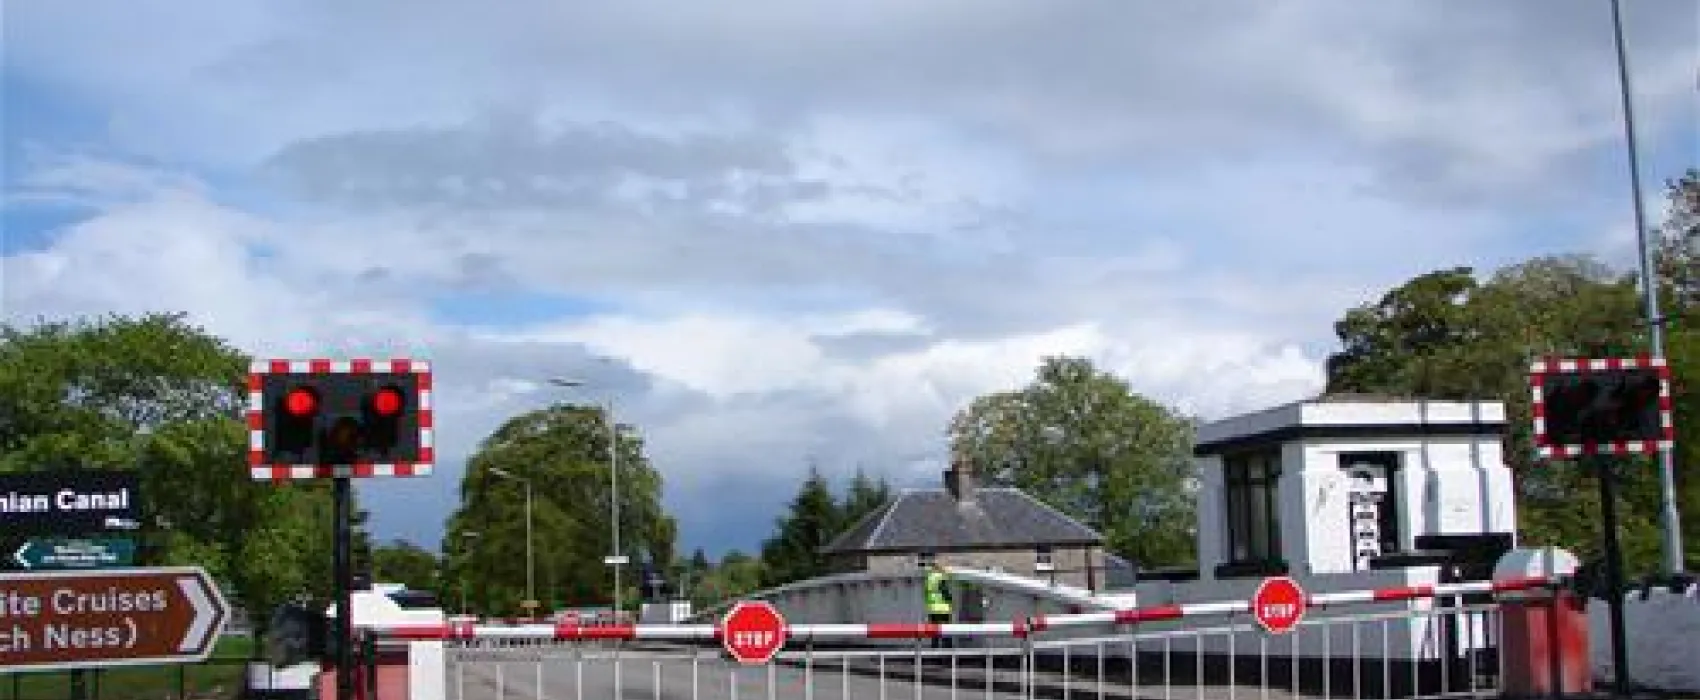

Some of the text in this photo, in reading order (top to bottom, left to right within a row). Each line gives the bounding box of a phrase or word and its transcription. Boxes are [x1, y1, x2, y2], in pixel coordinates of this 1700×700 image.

[56, 488, 129, 511] Canal
[53, 587, 168, 614] Cruises
[1263, 603, 1296, 618] STOP
[43, 617, 137, 650] Ness)
[733, 631, 775, 647] STOP
